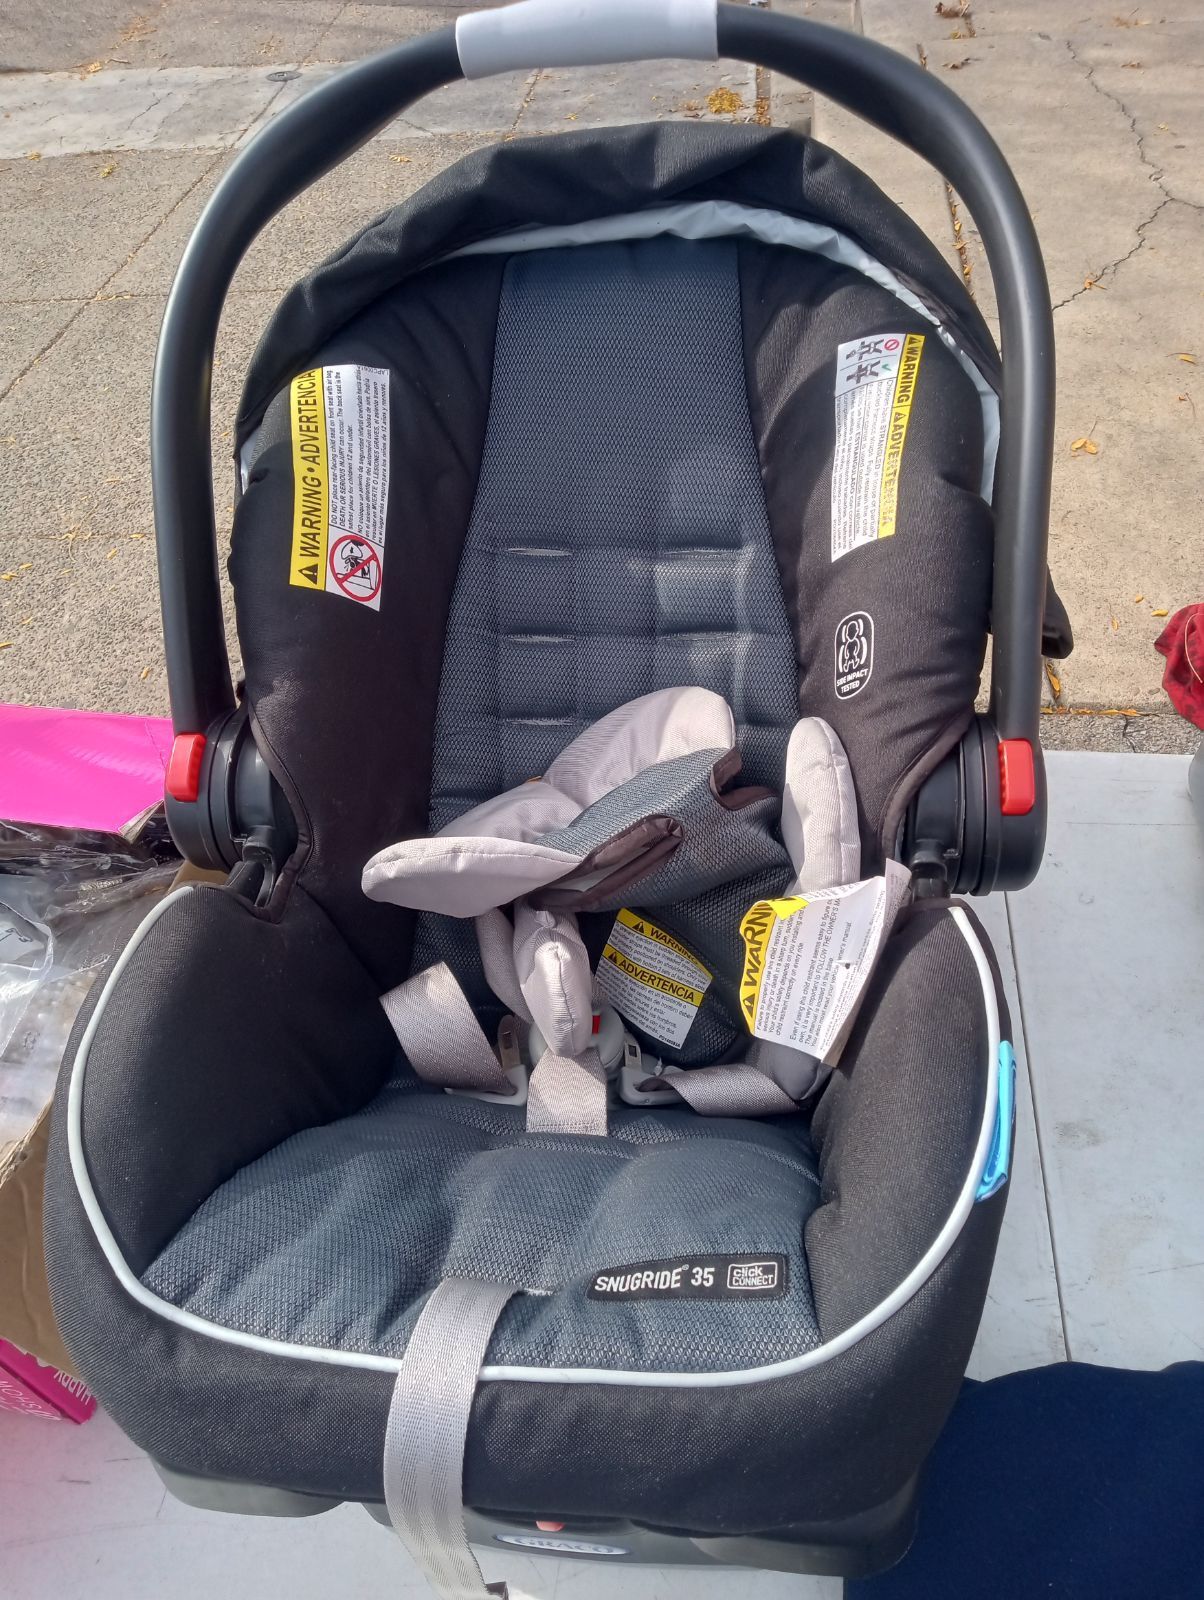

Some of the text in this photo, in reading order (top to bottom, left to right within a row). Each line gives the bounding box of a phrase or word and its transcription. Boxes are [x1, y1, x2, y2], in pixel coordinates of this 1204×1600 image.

[897, 346, 916, 403] WARNING
[297, 370, 321, 557] WARNING ADVERTENCIA
[846, 668, 868, 682] IMPACT
[841, 680, 860, 693] TESTED
[768, 946, 777, 959] child
[815, 947, 827, 973] FOLLOW
[822, 934, 831, 948] THE
[835, 942, 845, 960] wner's
[618, 959, 694, 1002] ADVERTENCIA
[789, 1025, 799, 1040] Even
[801, 981, 811, 995] child
[690, 1266, 715, 1287] 35
[732, 1274, 774, 1286] CONNECT
